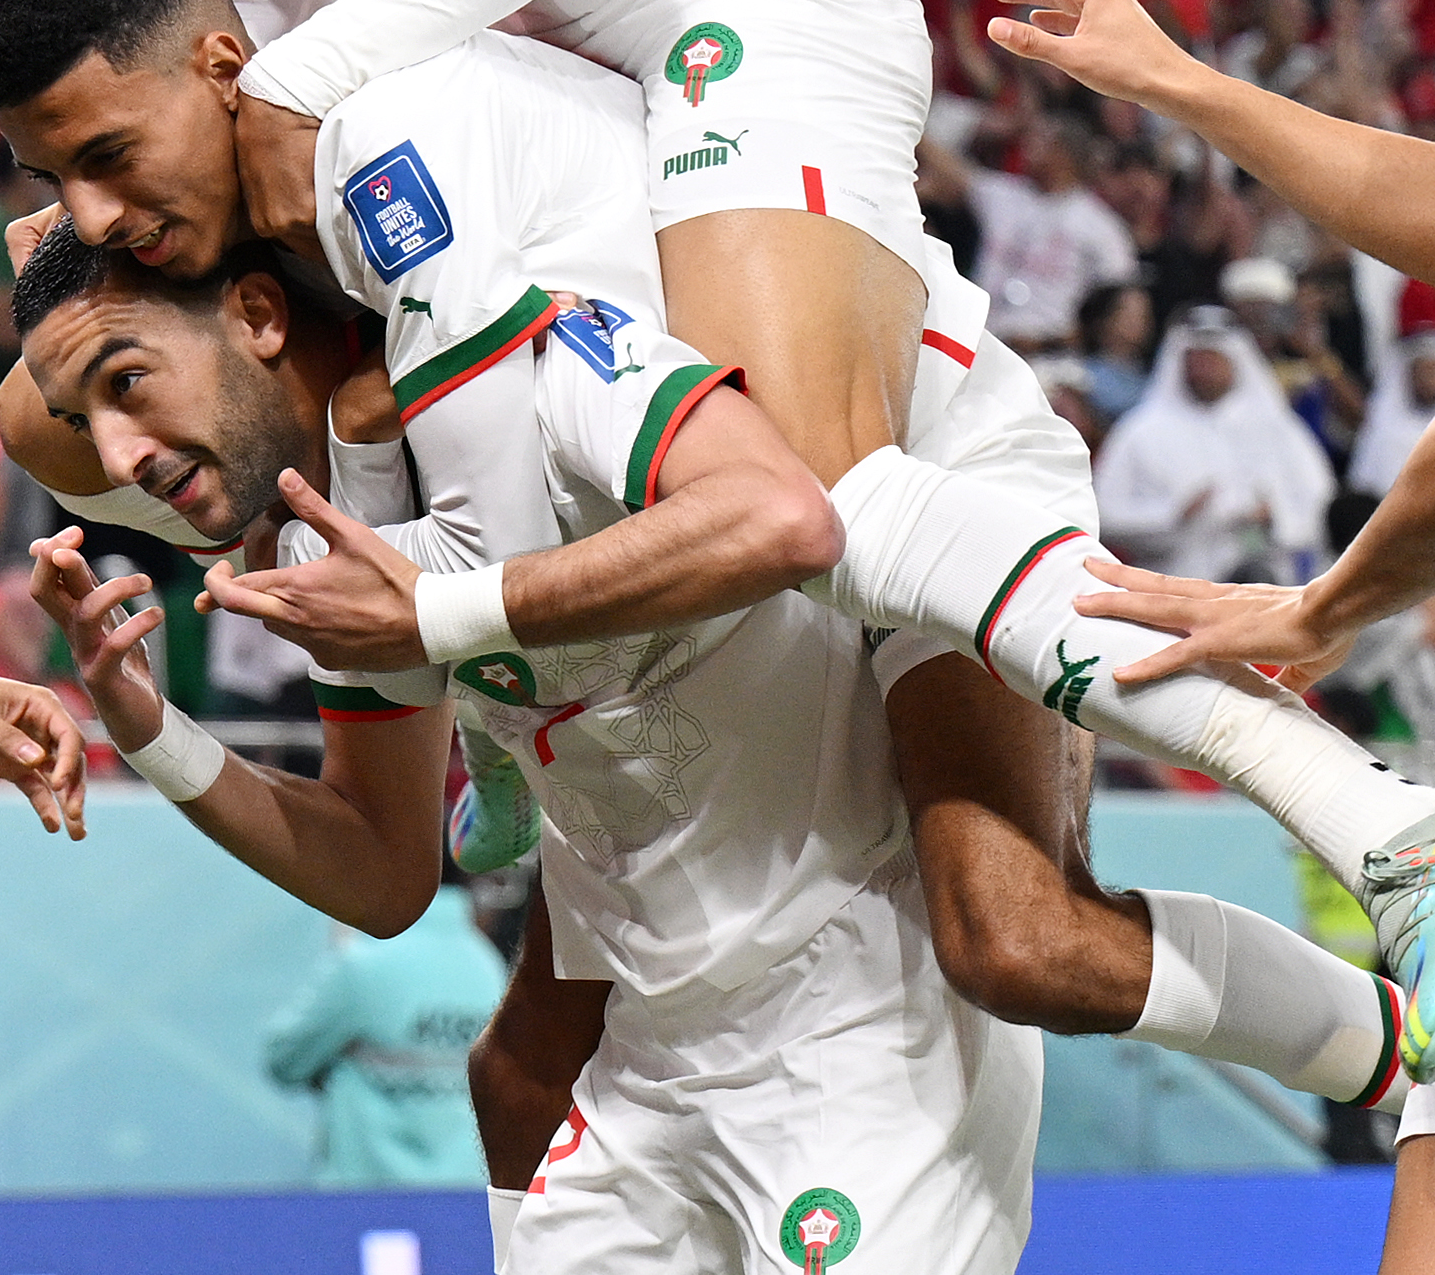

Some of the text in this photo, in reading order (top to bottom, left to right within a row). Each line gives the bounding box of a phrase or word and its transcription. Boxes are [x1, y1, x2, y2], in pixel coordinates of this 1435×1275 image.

[663, 146, 728, 180] PUMA
[375, 196, 411, 223] FOOTBALL
[380, 206, 417, 235] UNITES
[398, 216, 426, 239] World
[404, 238, 420, 249] FIFA
